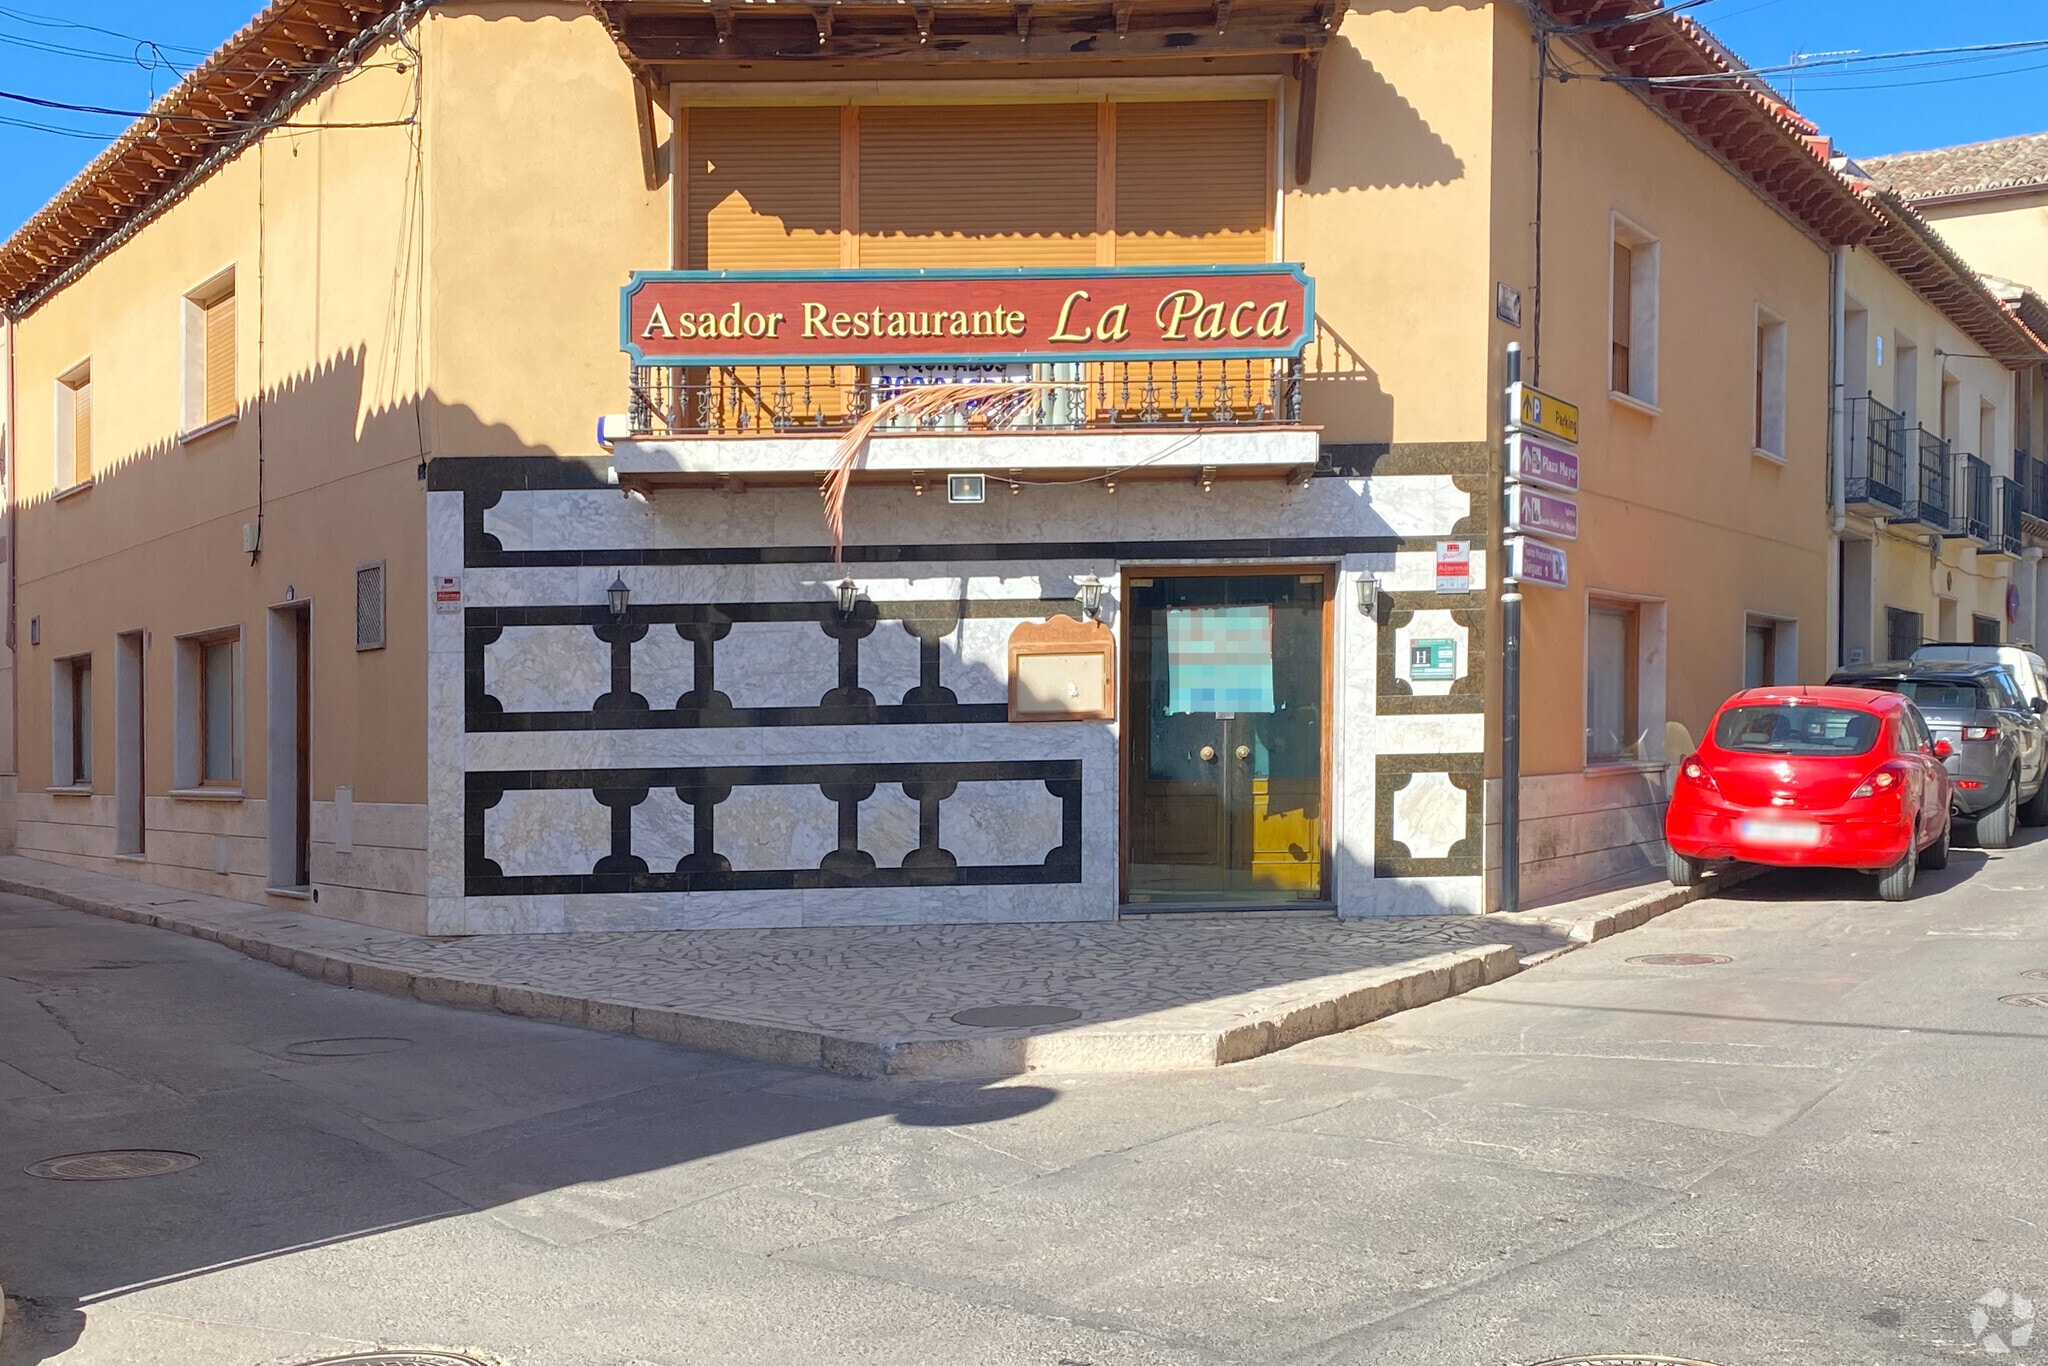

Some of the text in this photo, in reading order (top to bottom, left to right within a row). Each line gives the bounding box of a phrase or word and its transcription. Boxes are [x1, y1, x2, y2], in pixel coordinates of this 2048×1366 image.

[640, 289, 1290, 343] Asador Restaurante La Paca
[1533, 398, 1577, 435] P Parking
[1542, 455, 1577, 480] Plaza Mayor
